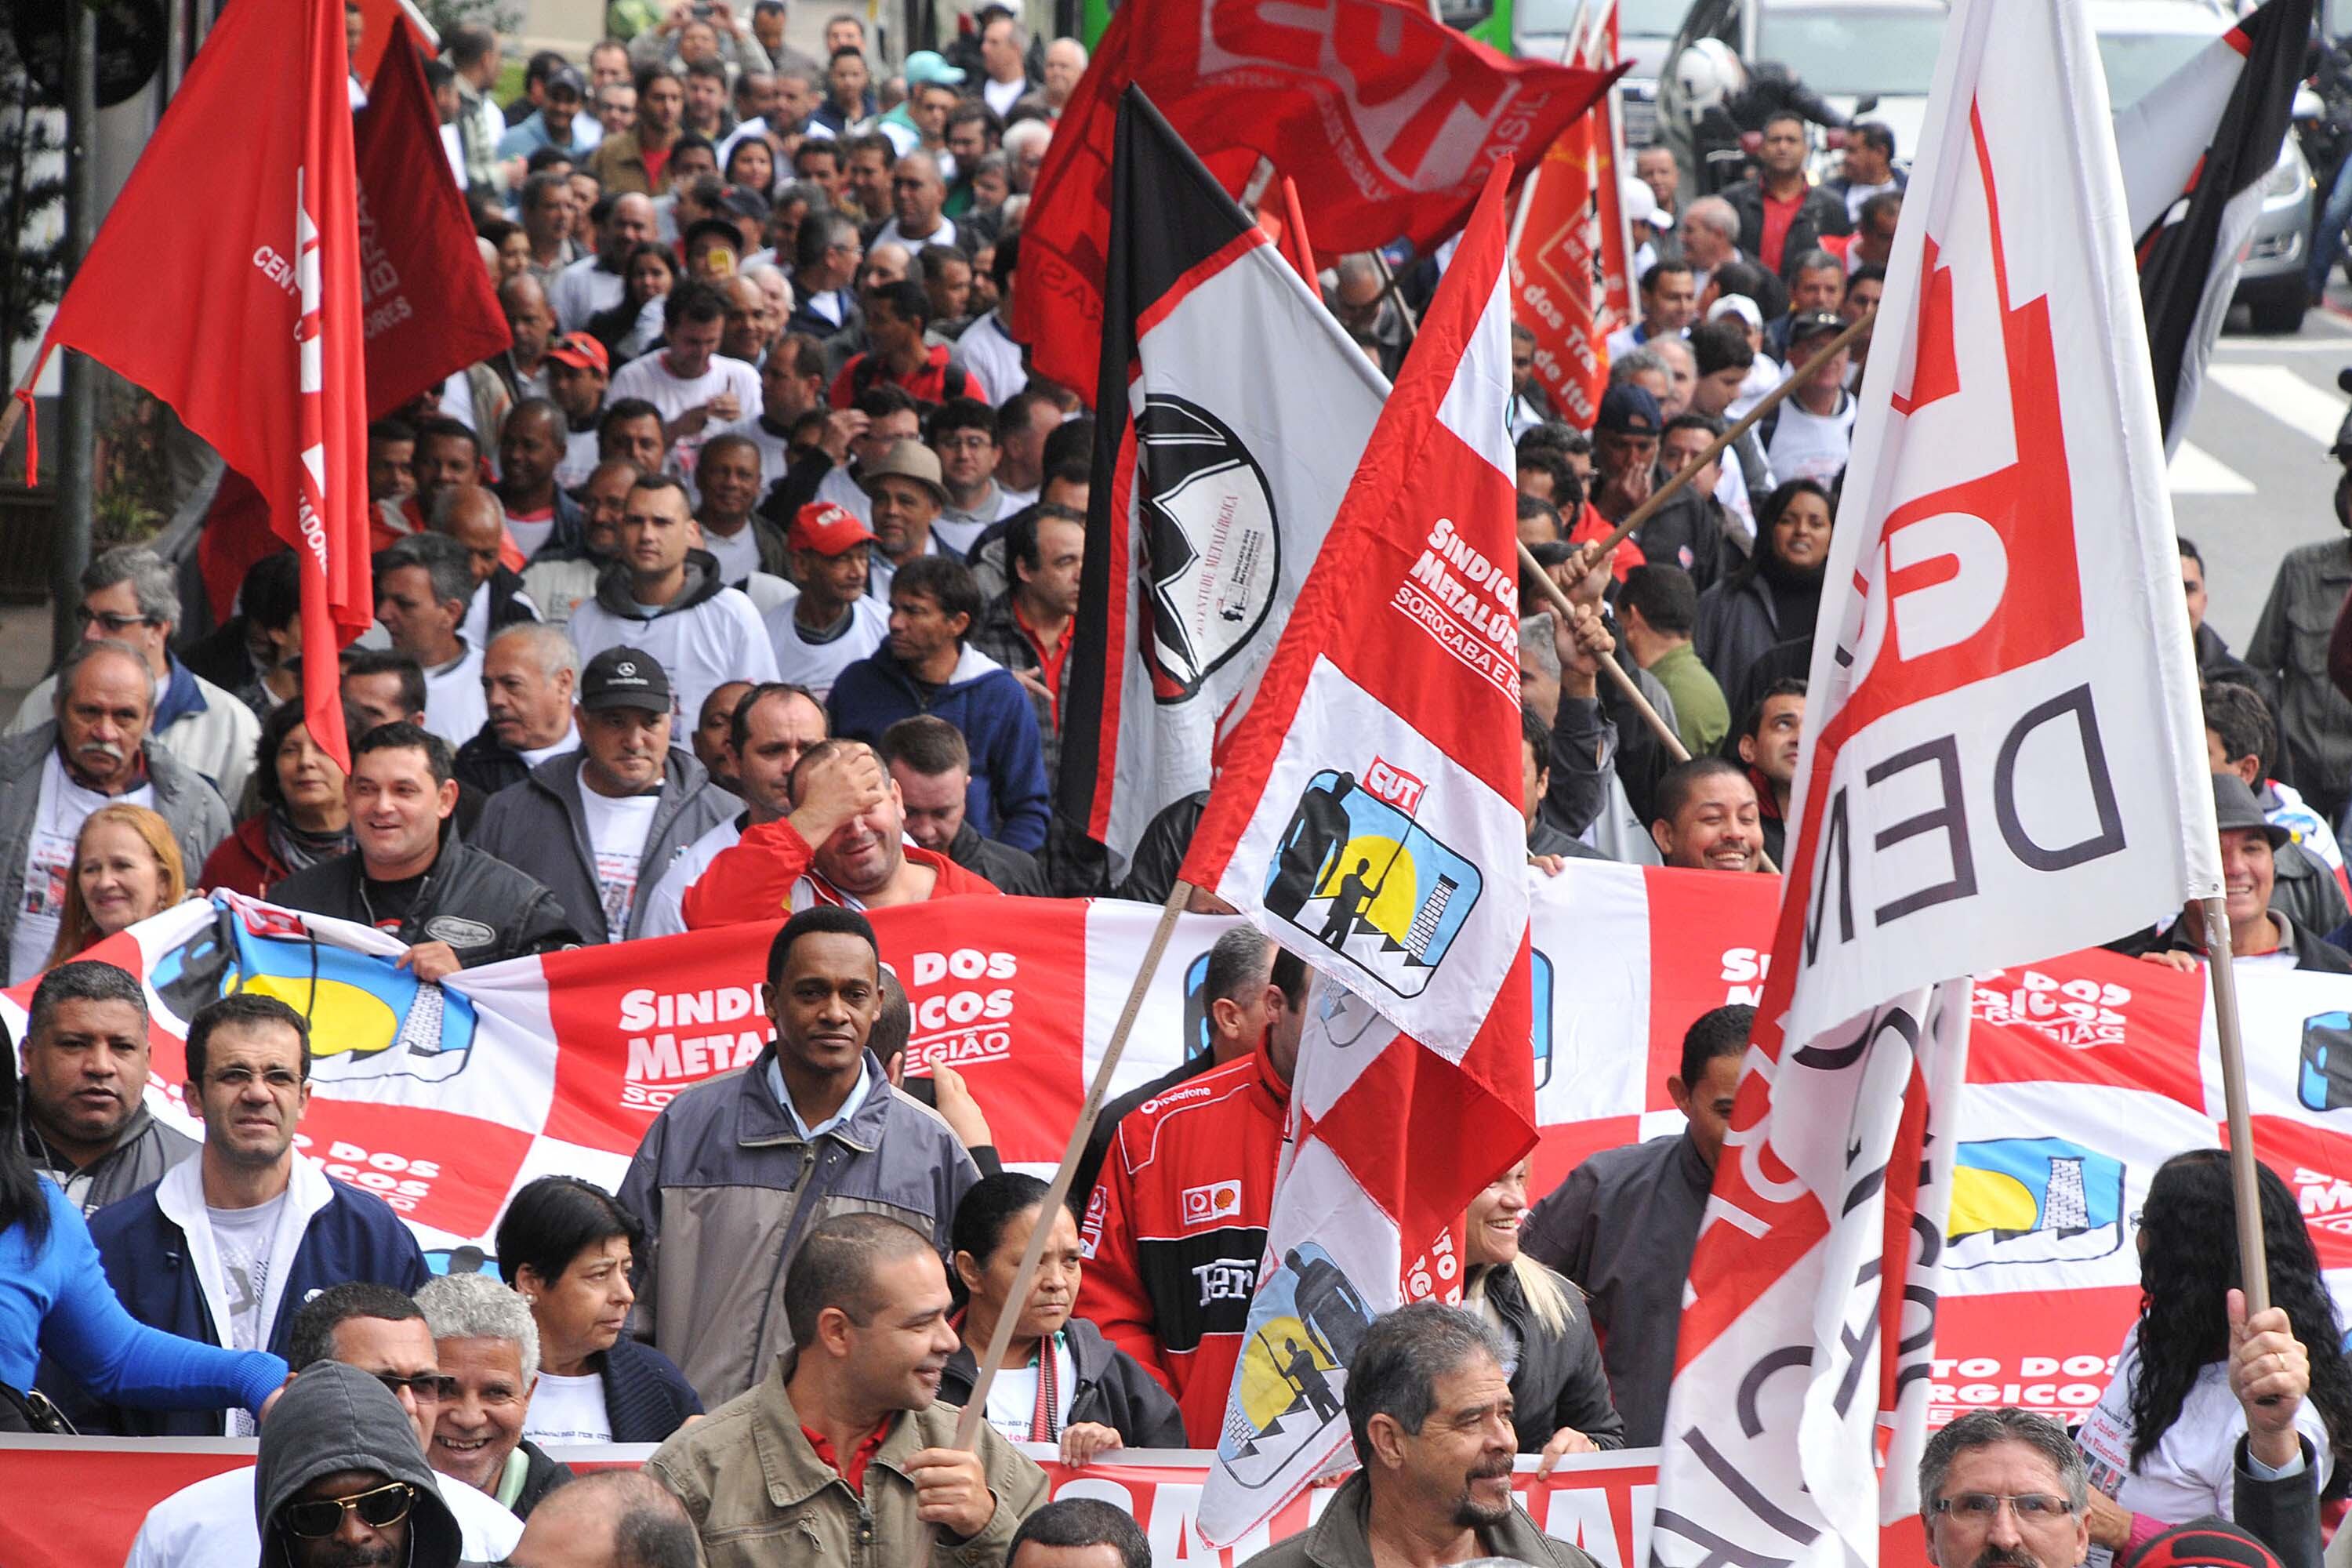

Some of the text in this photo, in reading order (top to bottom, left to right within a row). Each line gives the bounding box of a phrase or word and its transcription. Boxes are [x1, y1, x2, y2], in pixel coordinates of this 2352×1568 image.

[252, 245, 297, 296] CEN
[1196, 494, 1240, 639] JUVENTUDE METALÚRGICA
[1408, 549, 1520, 666] METALÚR
[1395, 586, 1491, 671] SOROCABA
[1491, 664, 1508, 683] E
[1369, 762, 1421, 808] CUT
[913, 948, 1018, 987] DOS
[2022, 970, 2132, 1007] DOS
[1158, 1086, 1211, 1107] vodafone
[328, 1140, 441, 1178] DOS
